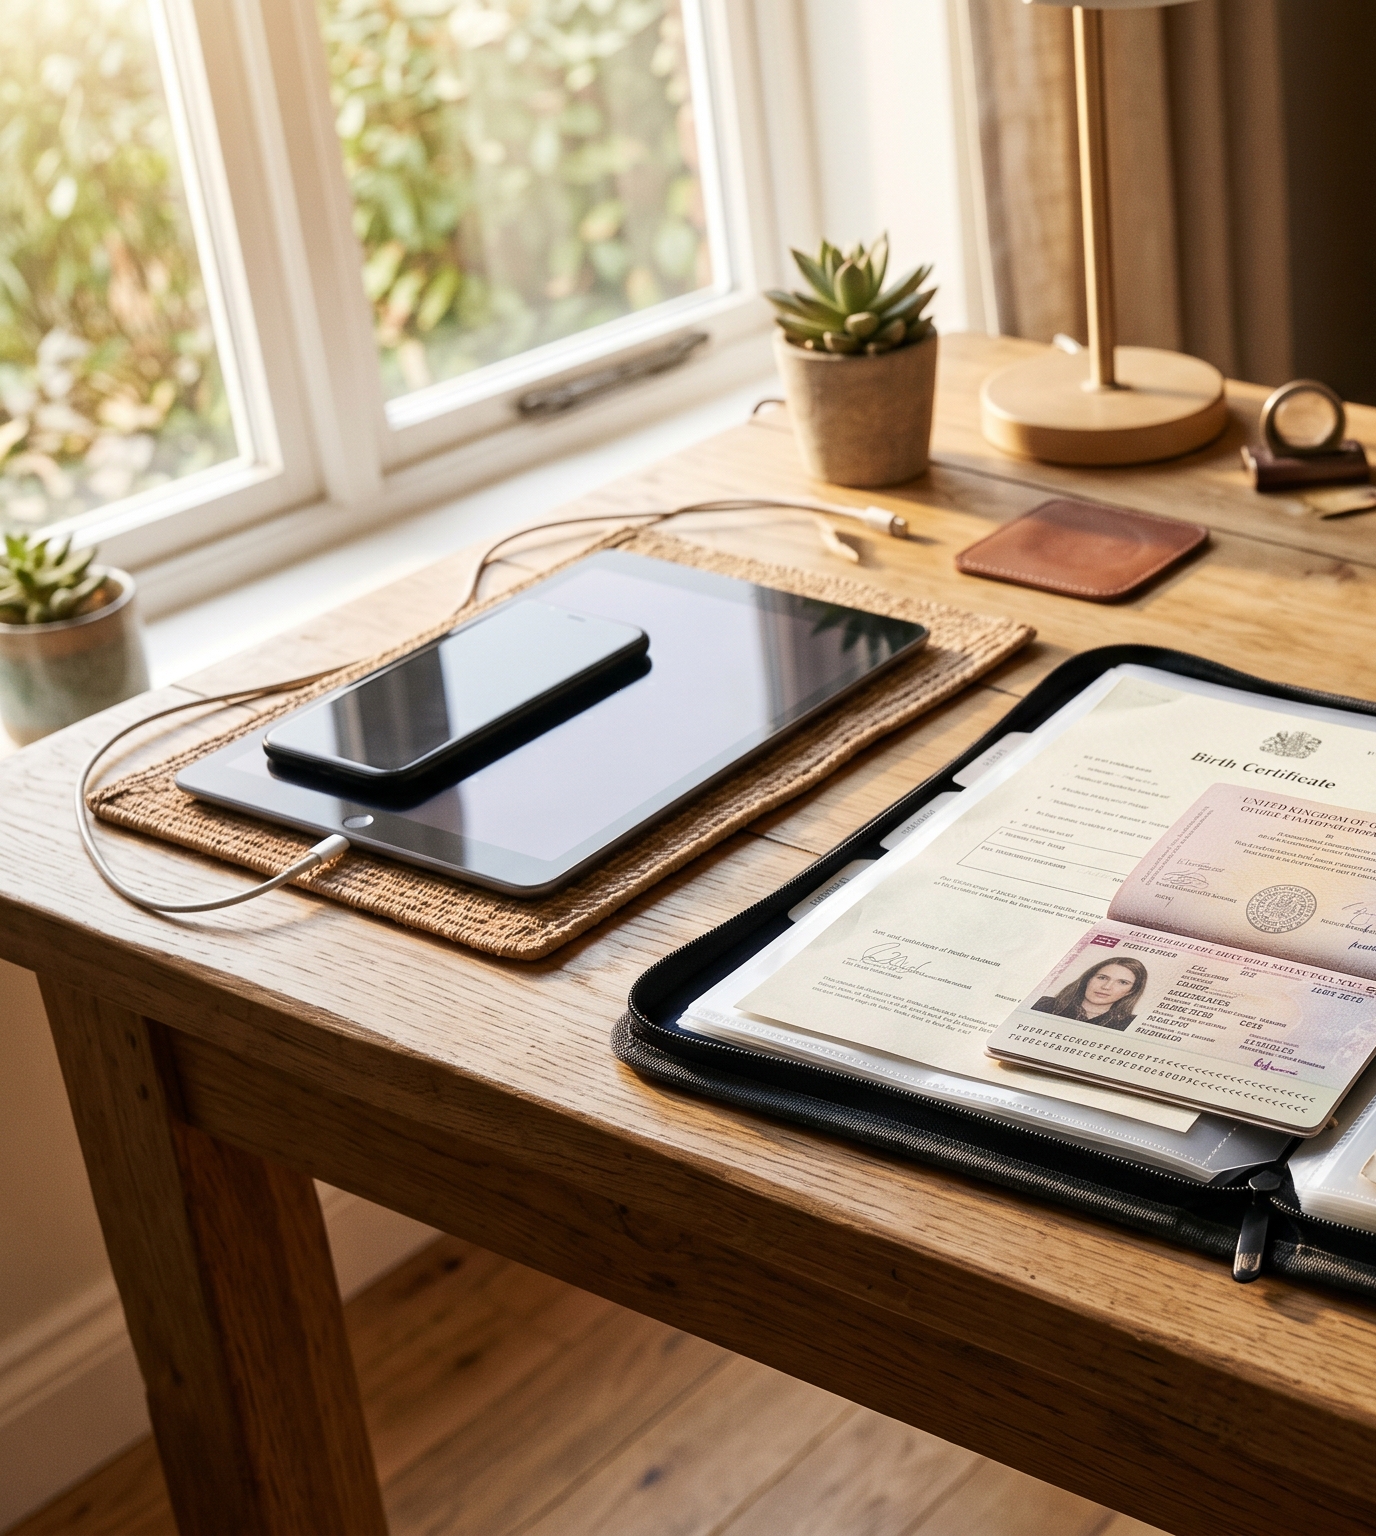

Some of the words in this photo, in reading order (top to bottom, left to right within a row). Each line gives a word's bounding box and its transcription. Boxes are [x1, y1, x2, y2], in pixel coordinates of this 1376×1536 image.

[1191, 752, 1235, 771] Birth
[1243, 762, 1336, 789] Certificate
[1243, 797, 1288, 812] UNITED
